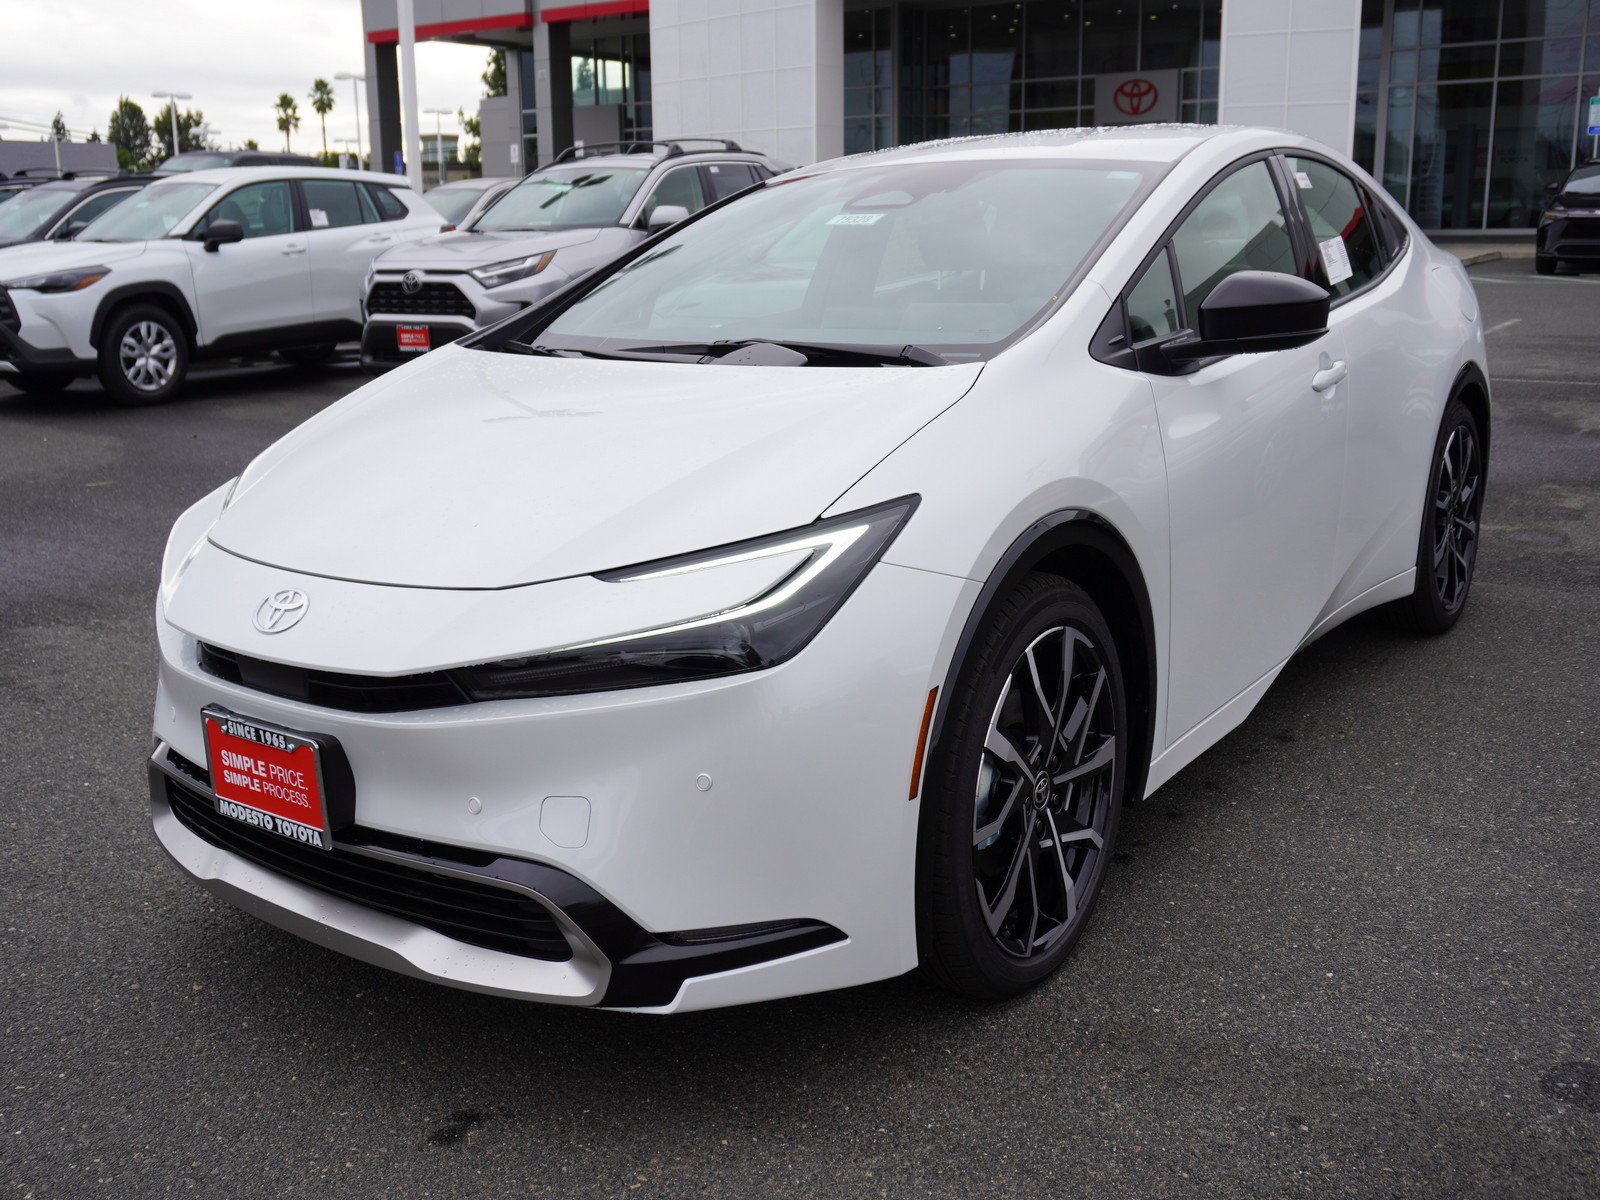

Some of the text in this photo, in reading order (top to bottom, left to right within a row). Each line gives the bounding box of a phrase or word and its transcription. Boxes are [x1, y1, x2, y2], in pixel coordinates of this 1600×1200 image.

[227, 720, 286, 749] SINCE 1965
[220, 749, 309, 791] SIMPLE PRICE.
[223, 770, 312, 809] SIMPLE PROCESS.
[219, 799, 323, 847] MODESTO TOYOTA
